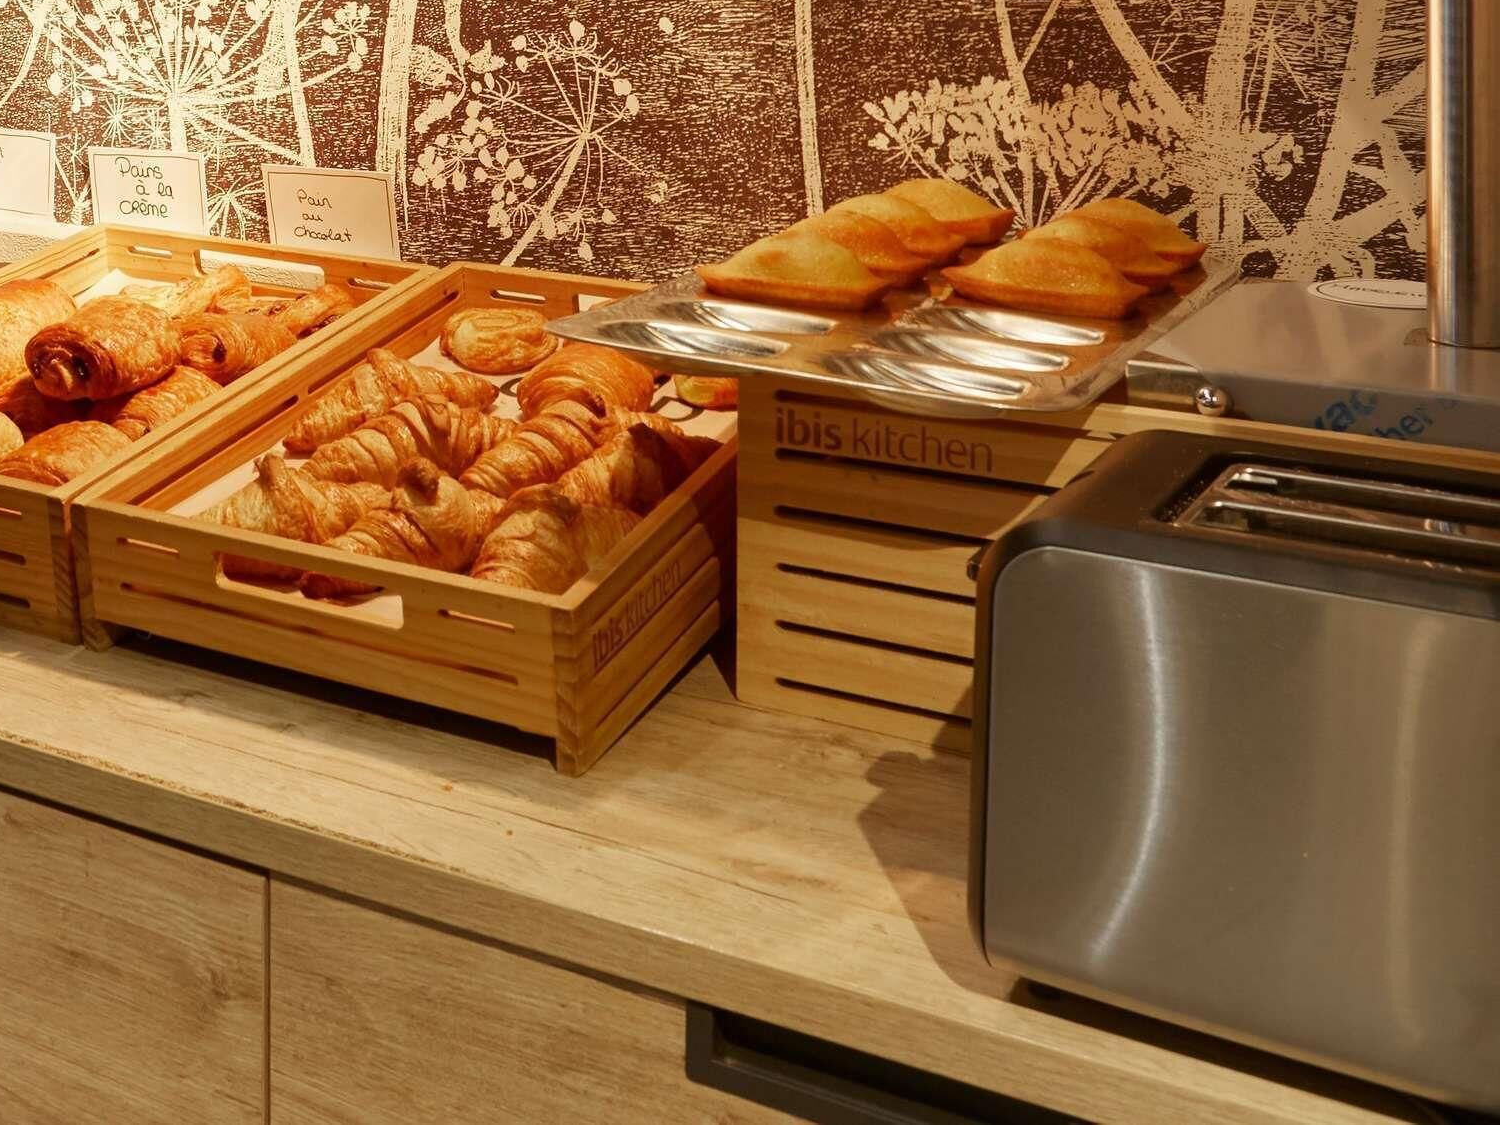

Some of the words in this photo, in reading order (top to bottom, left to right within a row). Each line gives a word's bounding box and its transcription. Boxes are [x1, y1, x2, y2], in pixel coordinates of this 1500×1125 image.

[114, 156, 163, 179] Pains
[135, 179, 150, 196] à
[157, 182, 174, 199] la
[296, 188, 333, 209] Pain
[301, 213, 323, 222] au
[774, 407, 842, 451] ibis
[852, 416, 994, 473] kitchen
[591, 617, 623, 668] ibis
[625, 559, 682, 633] kitchen
